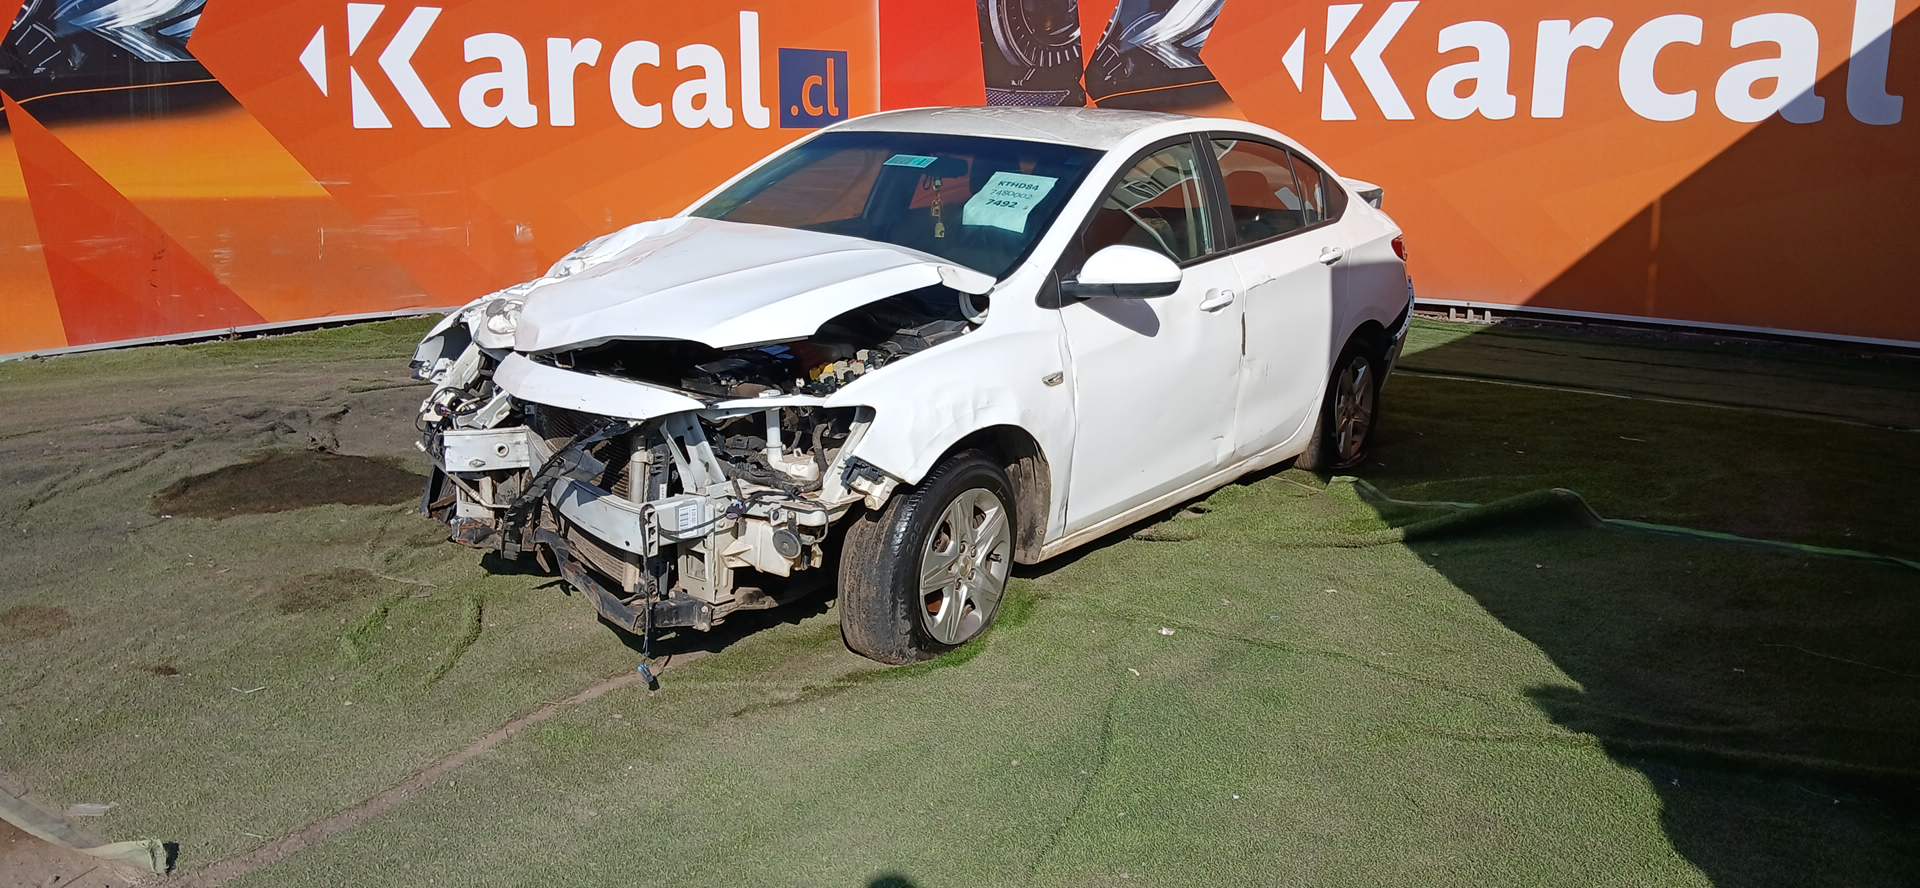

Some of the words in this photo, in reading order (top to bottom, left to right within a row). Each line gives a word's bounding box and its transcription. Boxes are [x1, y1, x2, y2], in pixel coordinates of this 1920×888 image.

[346, 2, 771, 129] Karcal
[790, 57, 839, 117] .cl
[1320, 0, 1905, 127] Karcal
[985, 199, 1018, 208] 7492
[998, 181, 1039, 191] KTHD84
